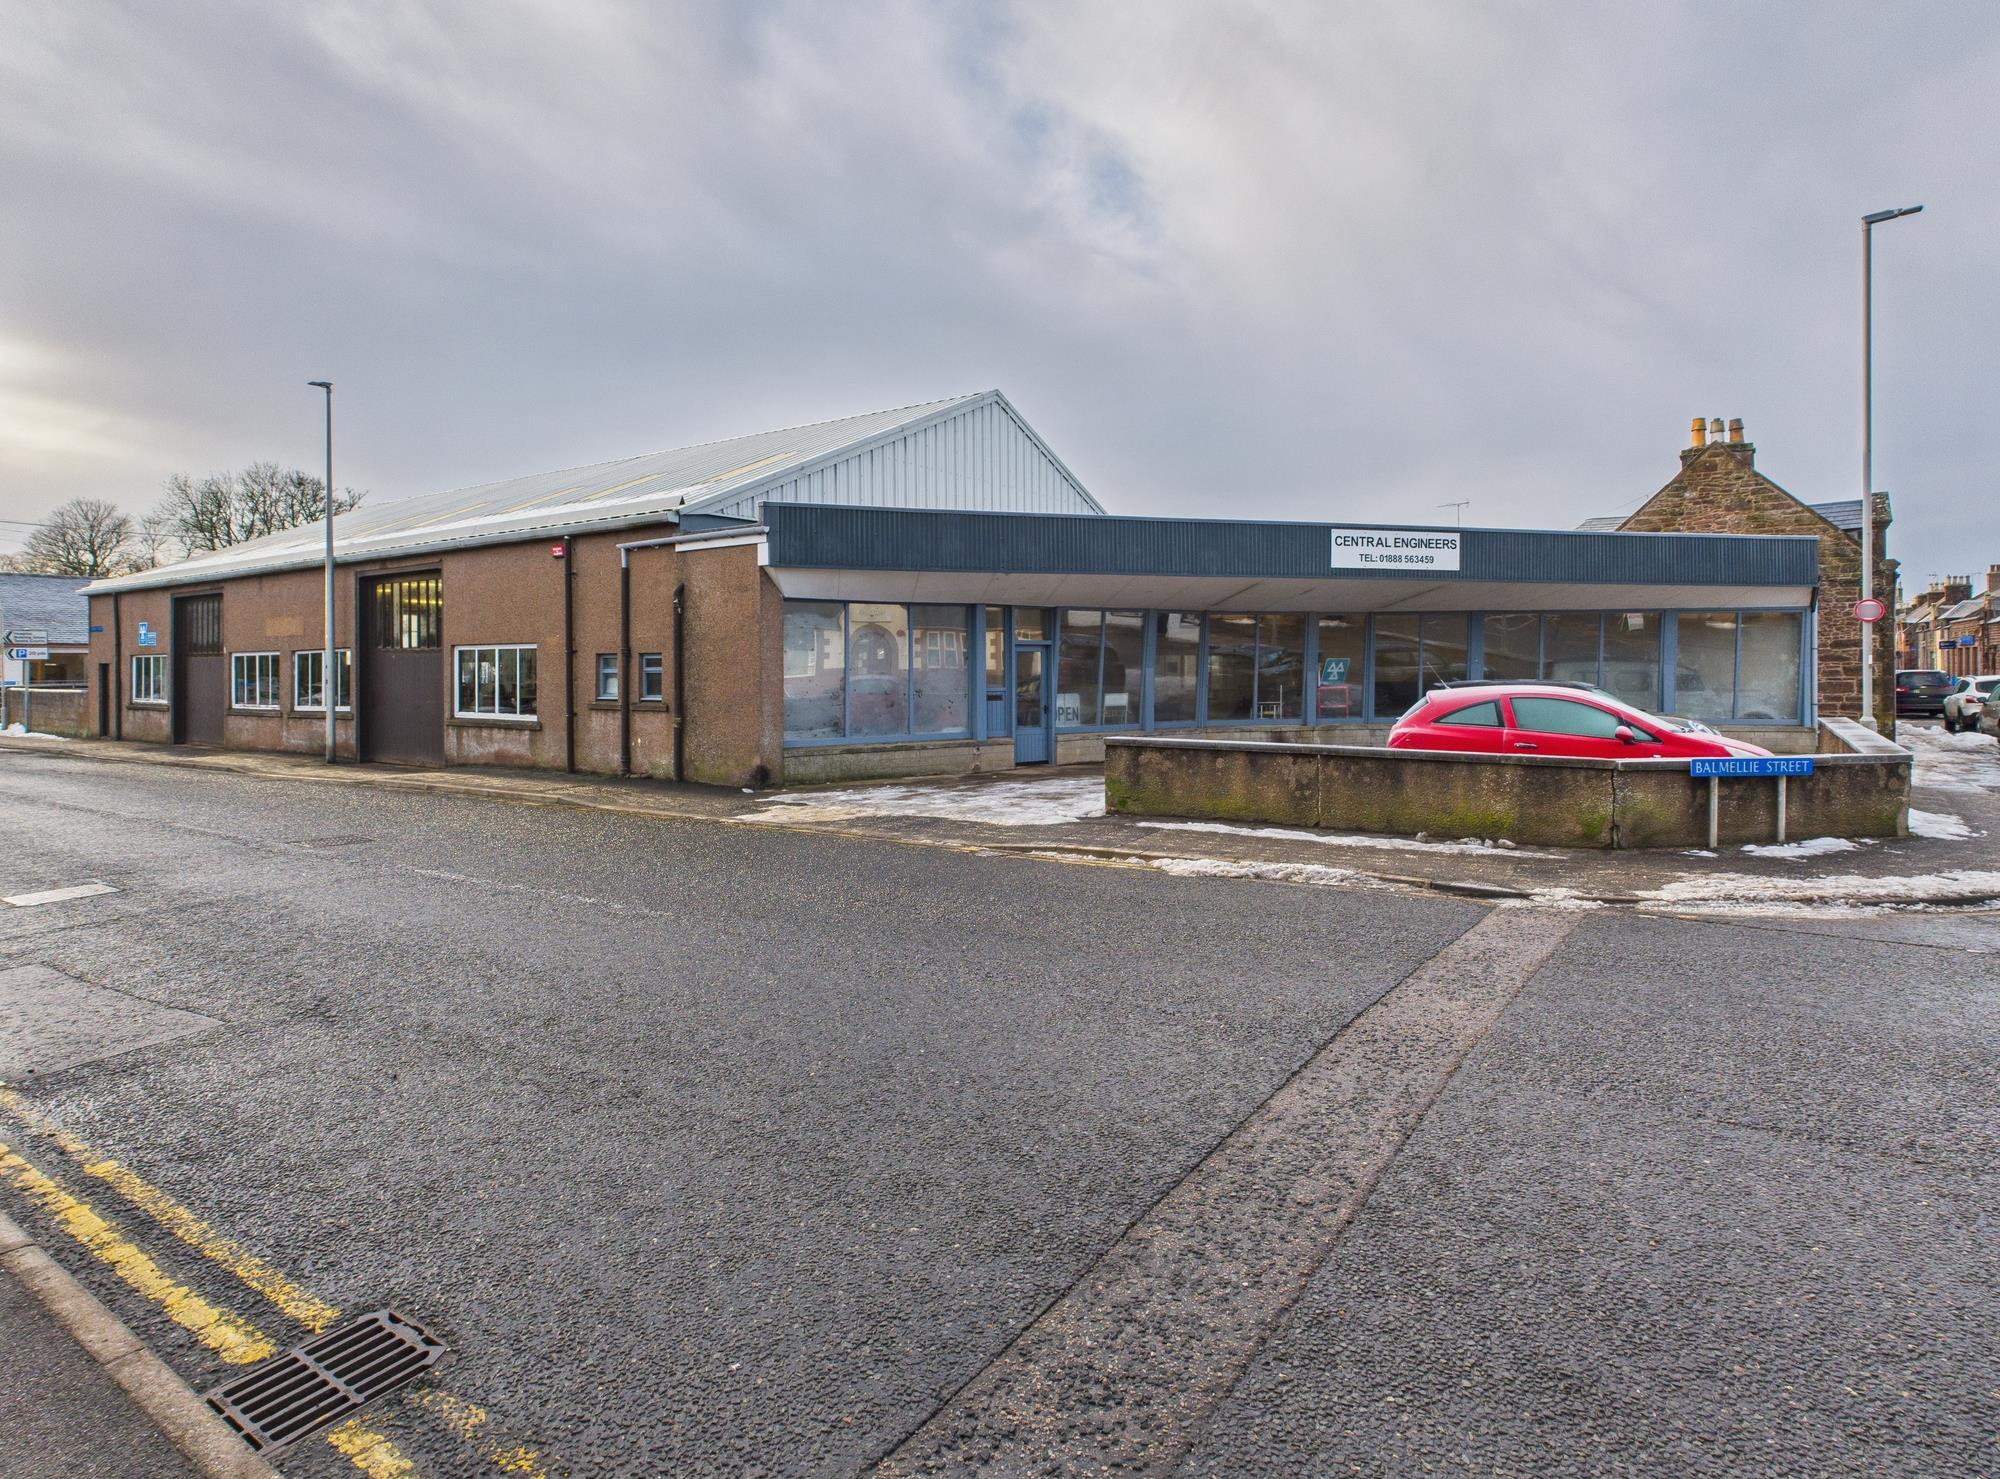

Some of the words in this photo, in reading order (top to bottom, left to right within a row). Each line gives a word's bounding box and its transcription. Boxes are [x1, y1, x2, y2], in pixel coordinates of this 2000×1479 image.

[1334, 535, 1392, 548] CENTRAL
[1393, 537, 1458, 550] ENGINEERS
[1358, 553, 1378, 563] TEL:
[1379, 554, 1403, 563] 01888
[1404, 555, 1435, 564] 563459
[1056, 706, 1080, 721] PEN
[1695, 761, 1760, 774] BALMELLIE
[1765, 760, 1810, 773] STREET
